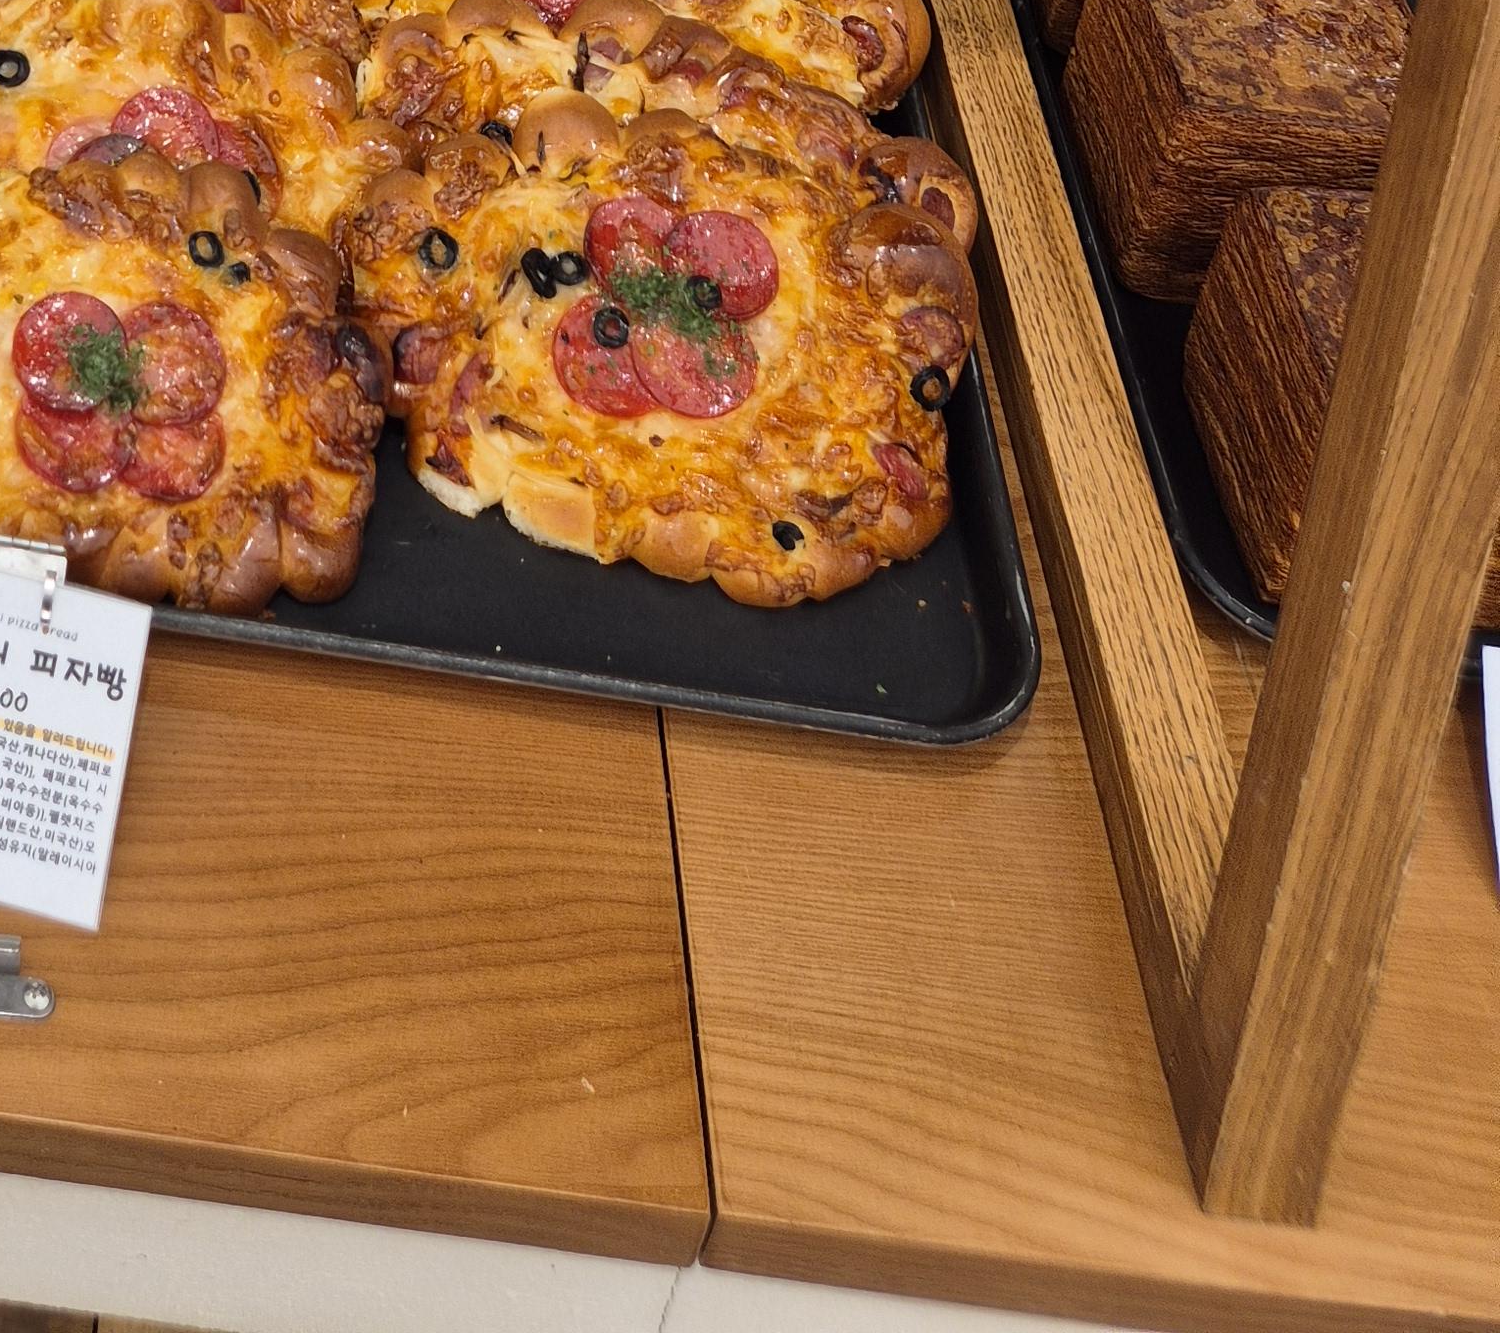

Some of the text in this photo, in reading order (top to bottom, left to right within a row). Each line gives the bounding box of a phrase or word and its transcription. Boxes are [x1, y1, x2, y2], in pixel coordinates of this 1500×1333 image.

[42, 623, 79, 643] read
[29, 648, 129, 701] 피자빵
[95, 781, 108, 796] 시
